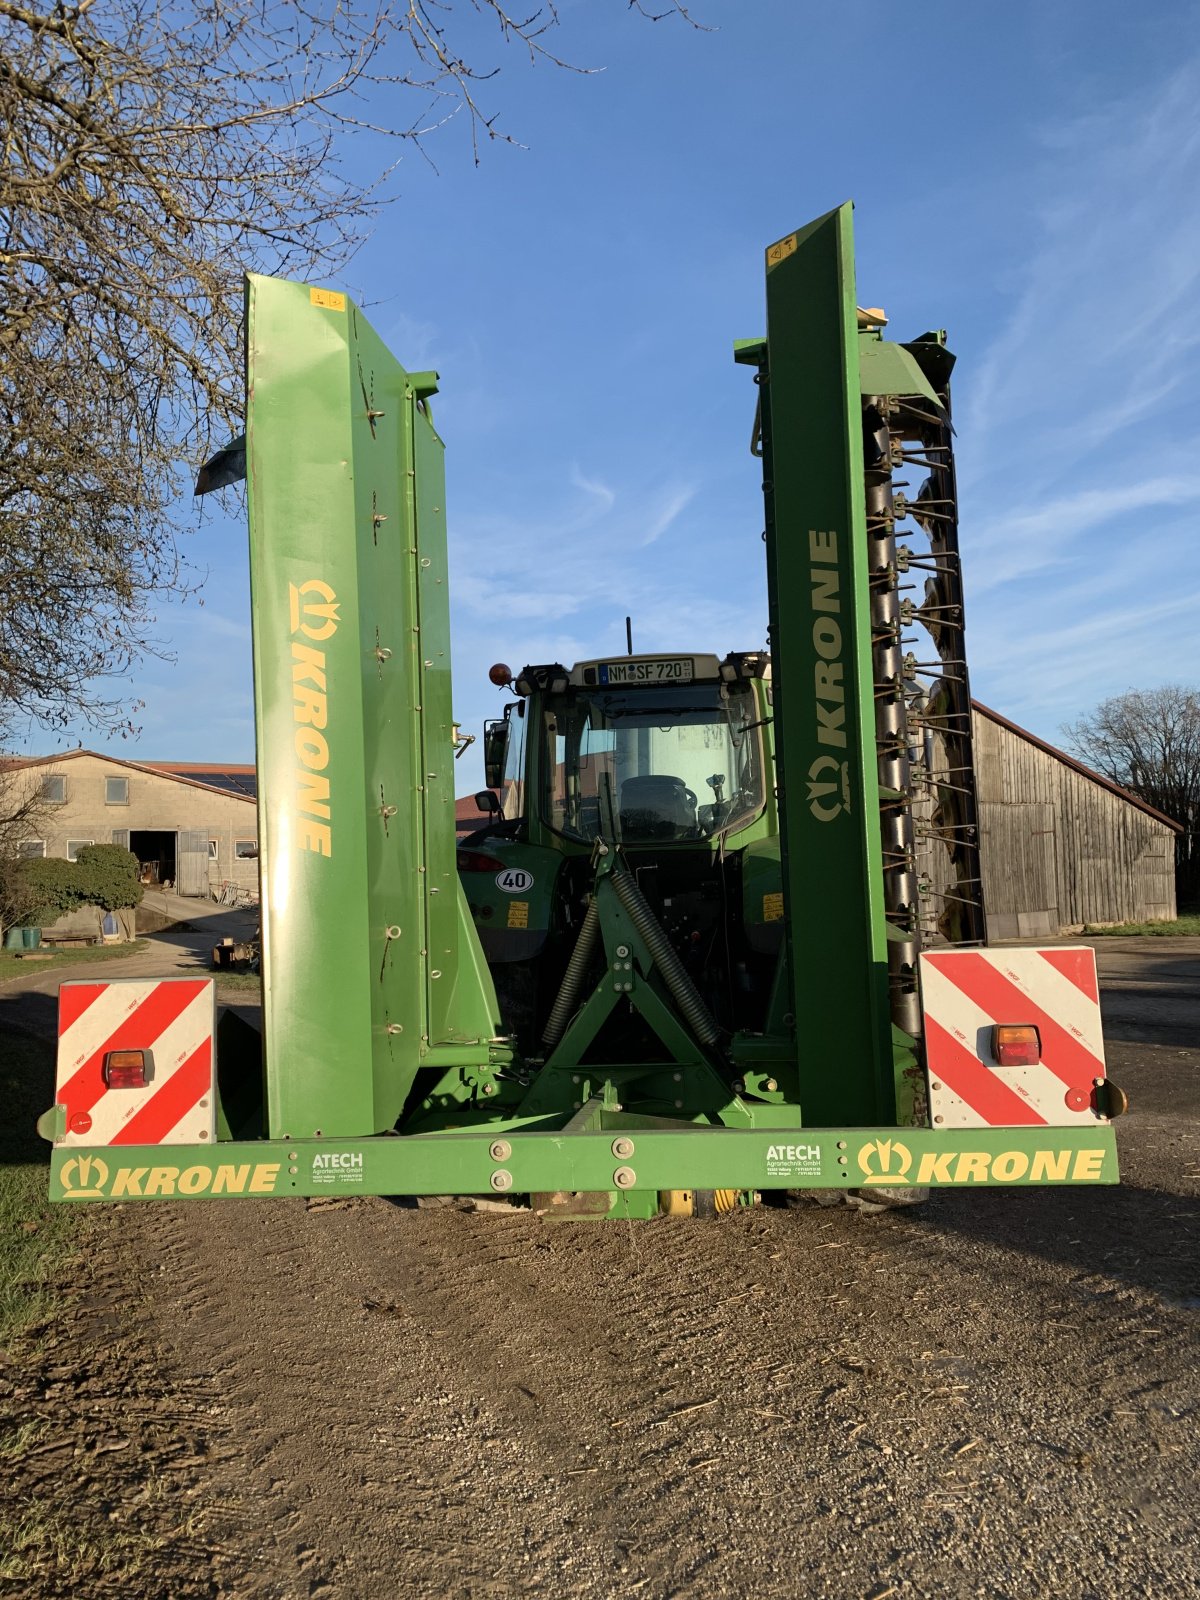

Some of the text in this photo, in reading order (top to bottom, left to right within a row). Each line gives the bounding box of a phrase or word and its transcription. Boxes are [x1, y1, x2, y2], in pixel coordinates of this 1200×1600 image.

[809, 530, 847, 748] KRONE
[609, 666, 626, 681] NM
[636, 664, 653, 679] SF
[656, 662, 682, 678] 720
[291, 642, 332, 857] KRONE
[503, 873, 526, 888] 40
[312, 1152, 363, 1168] ATECH
[766, 1145, 821, 1161] ATECH
[916, 1149, 1106, 1183] KRONE
[109, 1163, 281, 1197] KRONE
